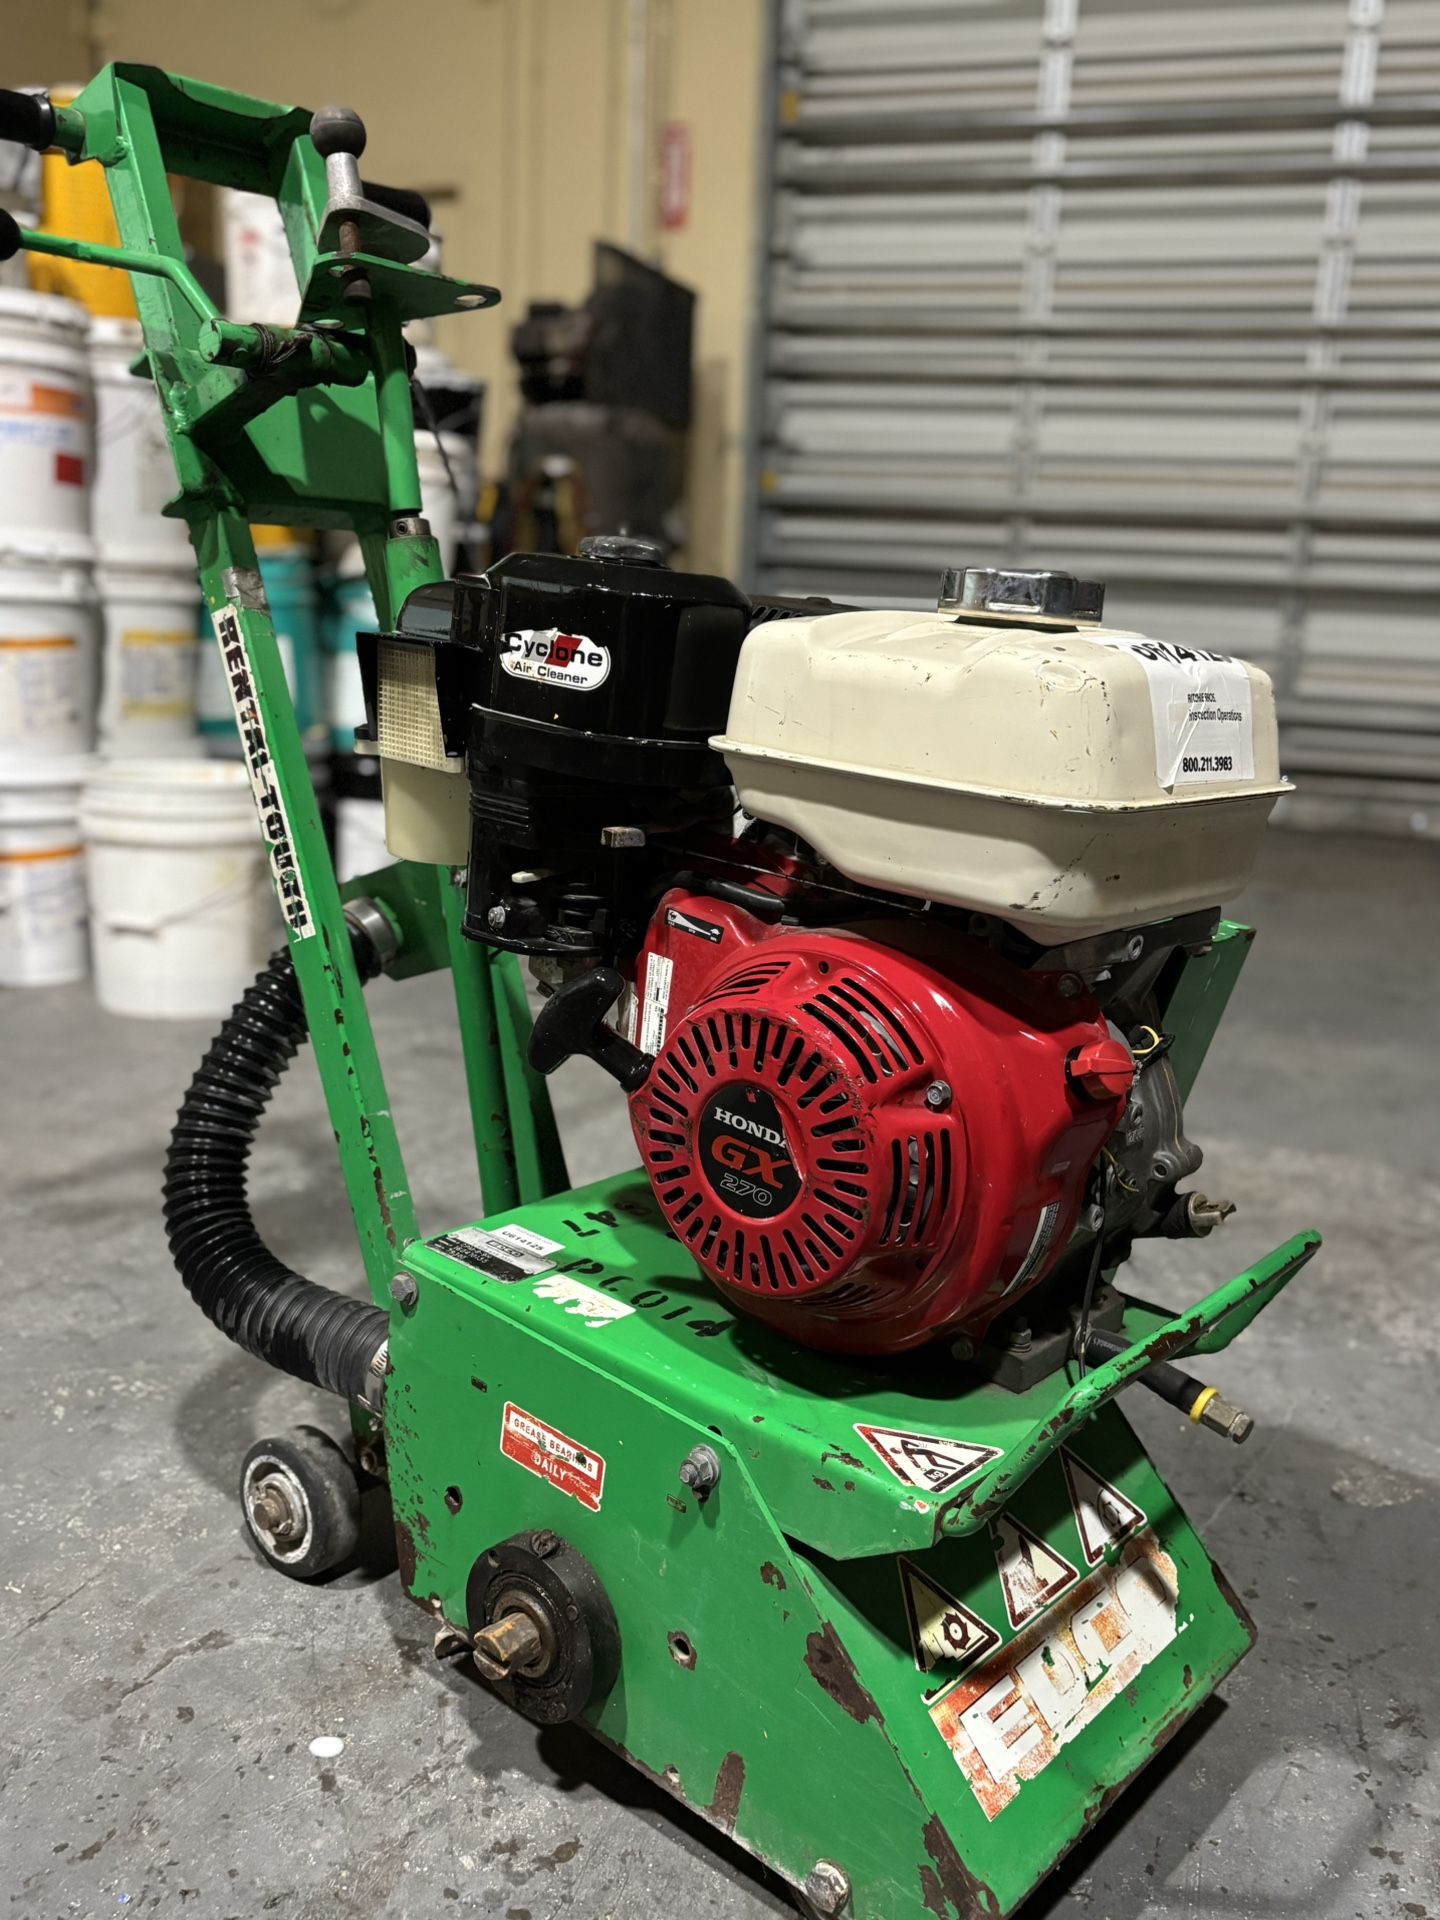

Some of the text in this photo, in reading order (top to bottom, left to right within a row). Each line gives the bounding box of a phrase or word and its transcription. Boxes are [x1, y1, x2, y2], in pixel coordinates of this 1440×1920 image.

[505, 632, 603, 667] Cyclone
[512, 661, 588, 684] Air Cleaner
[1217, 707, 1242, 724] Operations
[218, 616, 308, 929] RENTAL TOUGH
[1183, 756, 1232, 773] 800.211.3983
[711, 1135, 793, 1190] GX
[720, 1172, 773, 1207] 270
[514, 1418, 593, 1472] GREASE BEARIS
[531, 1449, 568, 1481] DAILY
[959, 1556, 1174, 1784] EDCO
